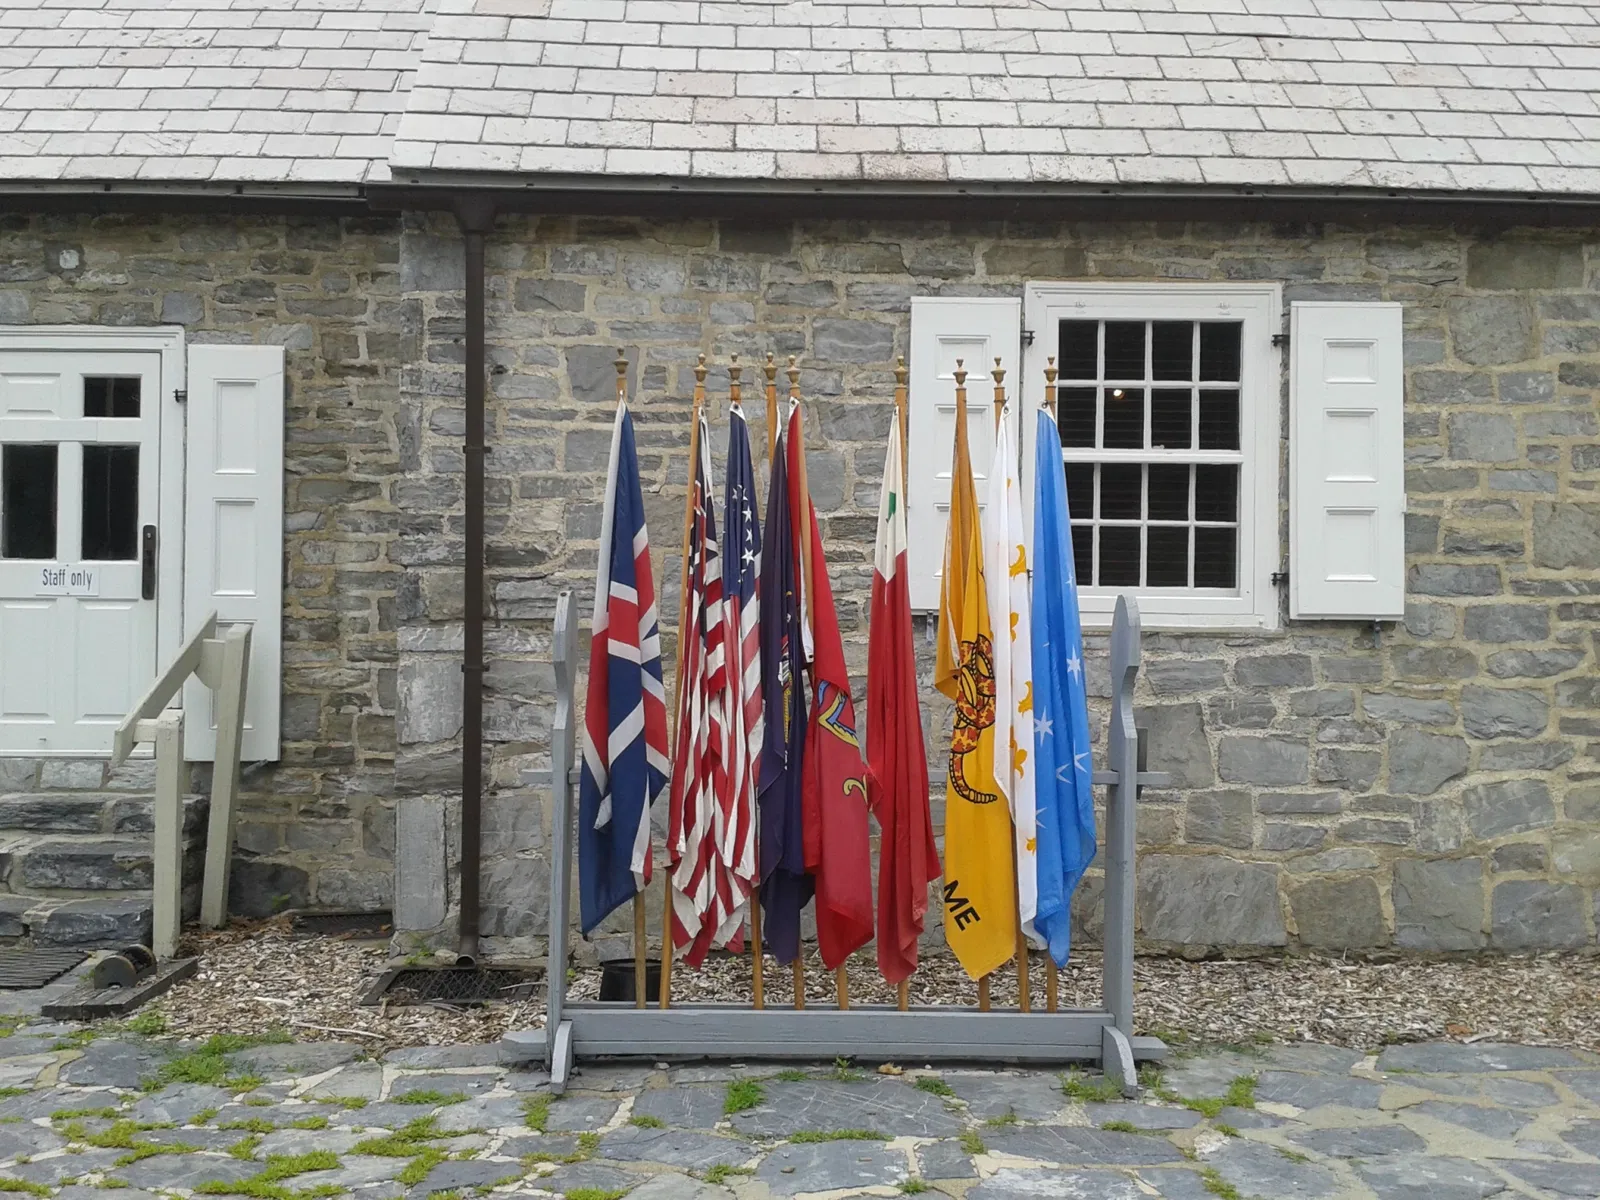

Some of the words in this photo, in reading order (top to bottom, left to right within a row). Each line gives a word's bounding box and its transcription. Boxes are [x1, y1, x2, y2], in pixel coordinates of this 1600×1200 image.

[42, 568, 66, 586] Staff
[71, 569, 92, 591] only
[944, 880, 981, 931] ME
